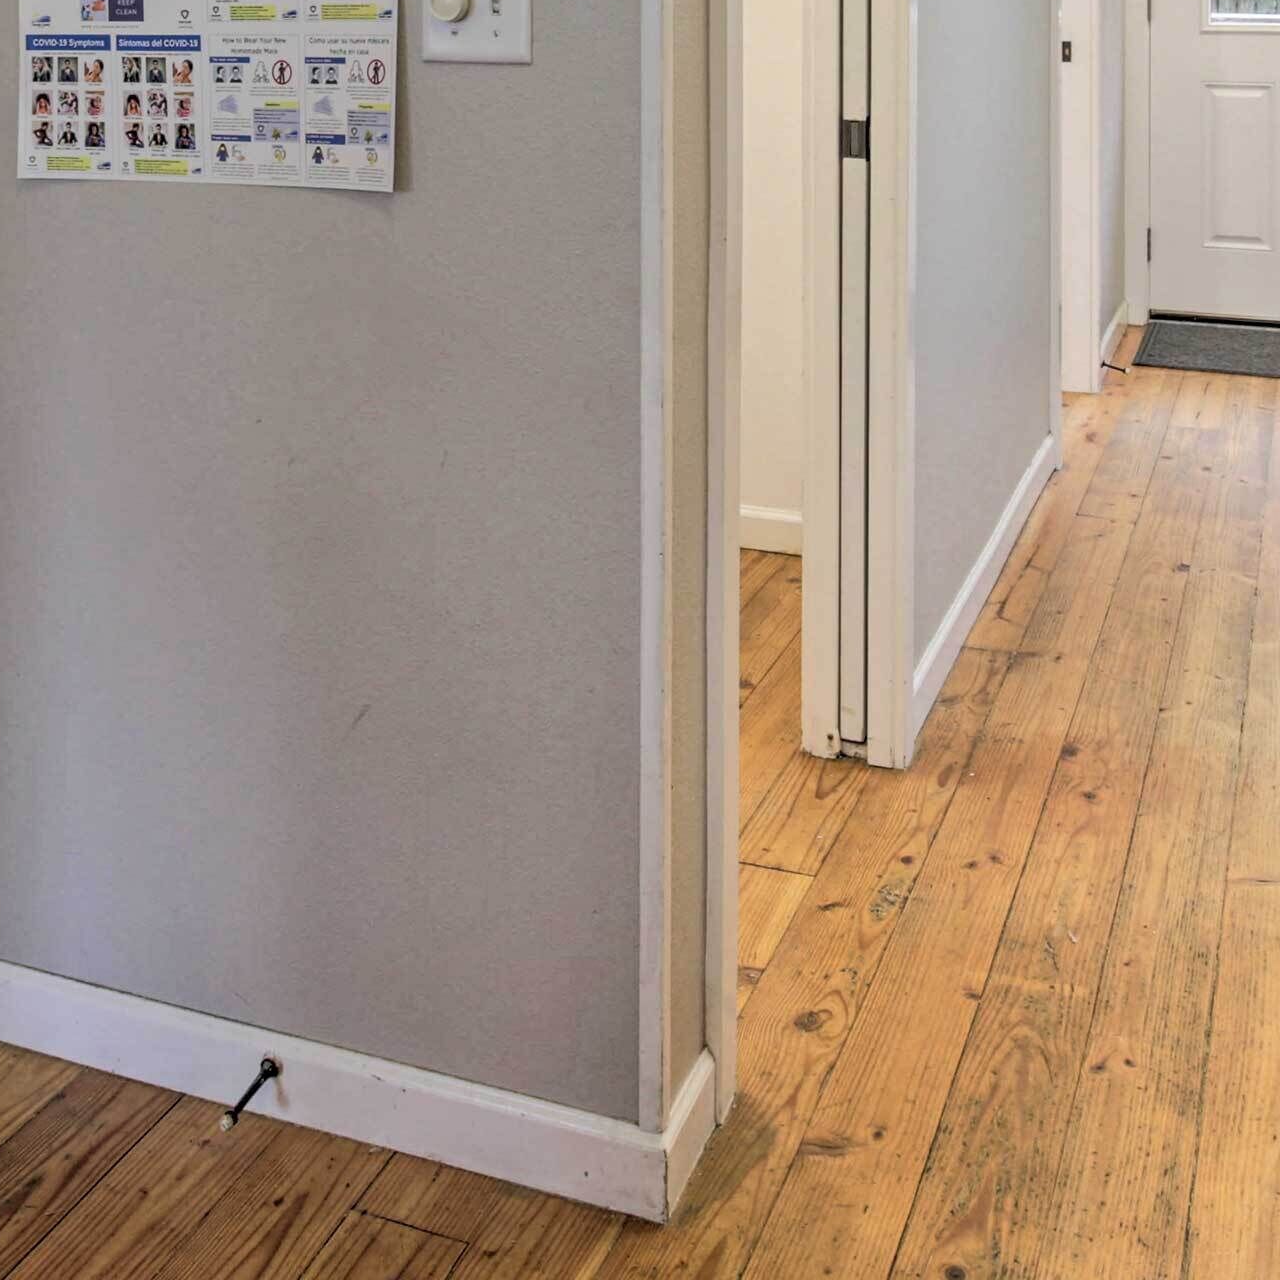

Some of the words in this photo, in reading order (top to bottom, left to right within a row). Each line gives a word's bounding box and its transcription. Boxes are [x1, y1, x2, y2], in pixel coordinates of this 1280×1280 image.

[115, 8, 137, 16] CLEAN
[32, 38, 68, 47] COVID-19
[69, 38, 105, 49] Symptoms
[151, 38, 162, 48] del
[163, 38, 199, 48] COVID-19
